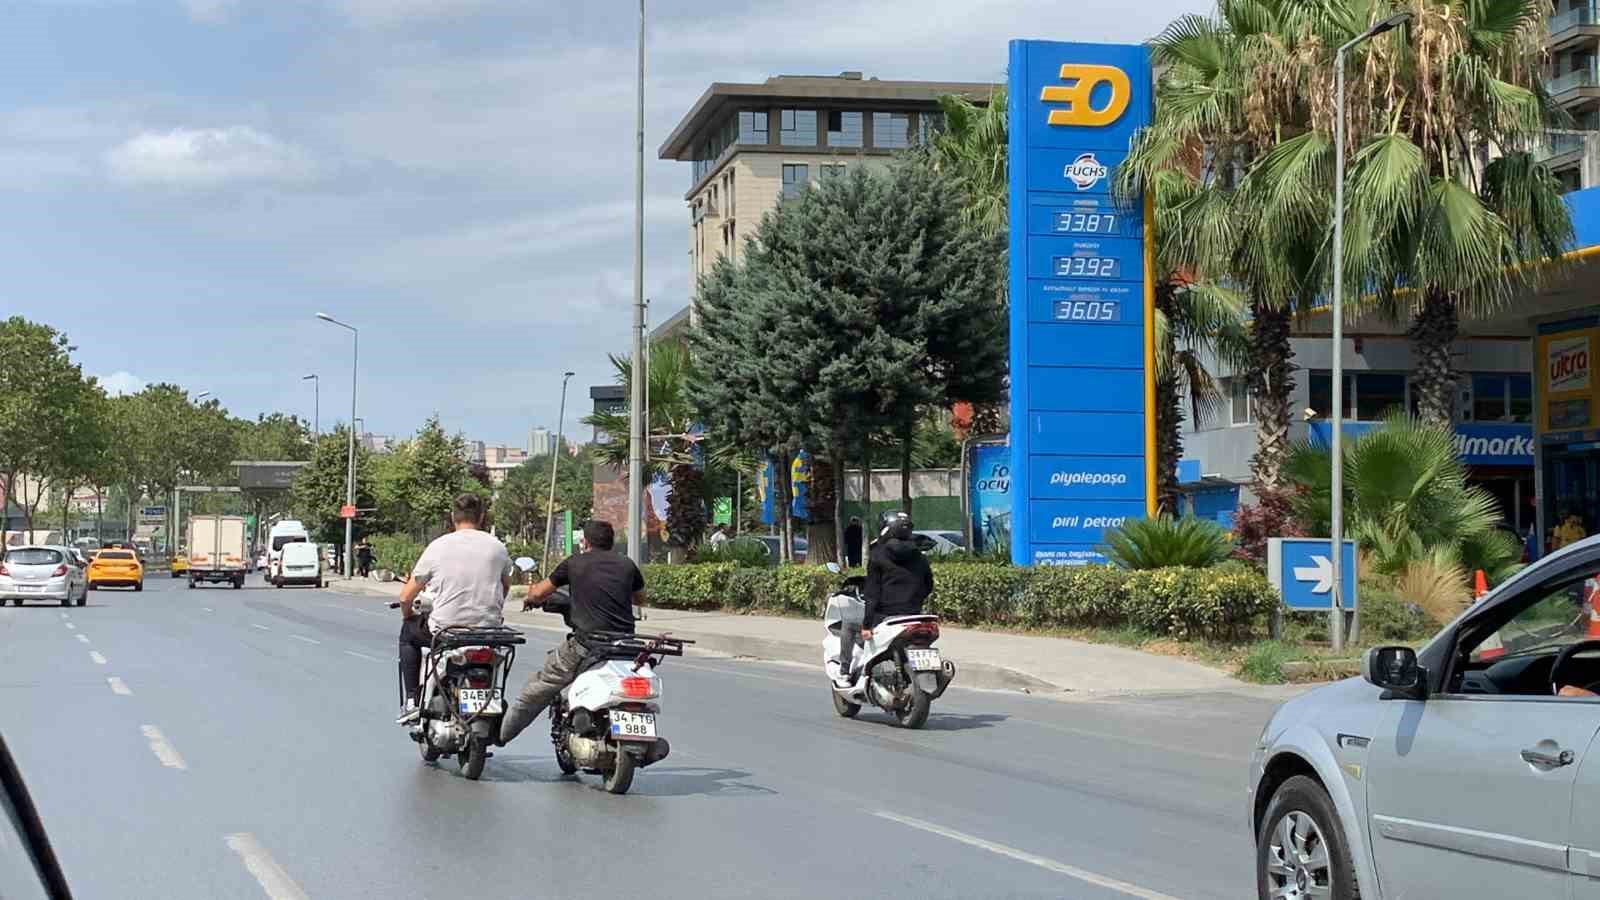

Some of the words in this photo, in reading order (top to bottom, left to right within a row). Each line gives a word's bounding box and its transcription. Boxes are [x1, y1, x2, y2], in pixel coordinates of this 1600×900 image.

[1065, 166, 1106, 177] FUCHS
[1056, 213, 1115, 233] 33.87
[1056, 301, 1115, 320] 36.05
[1050, 471, 1127, 487] piyalepaşa
[1083, 516, 1126, 529] petrol
[625, 724, 648, 735] 988
